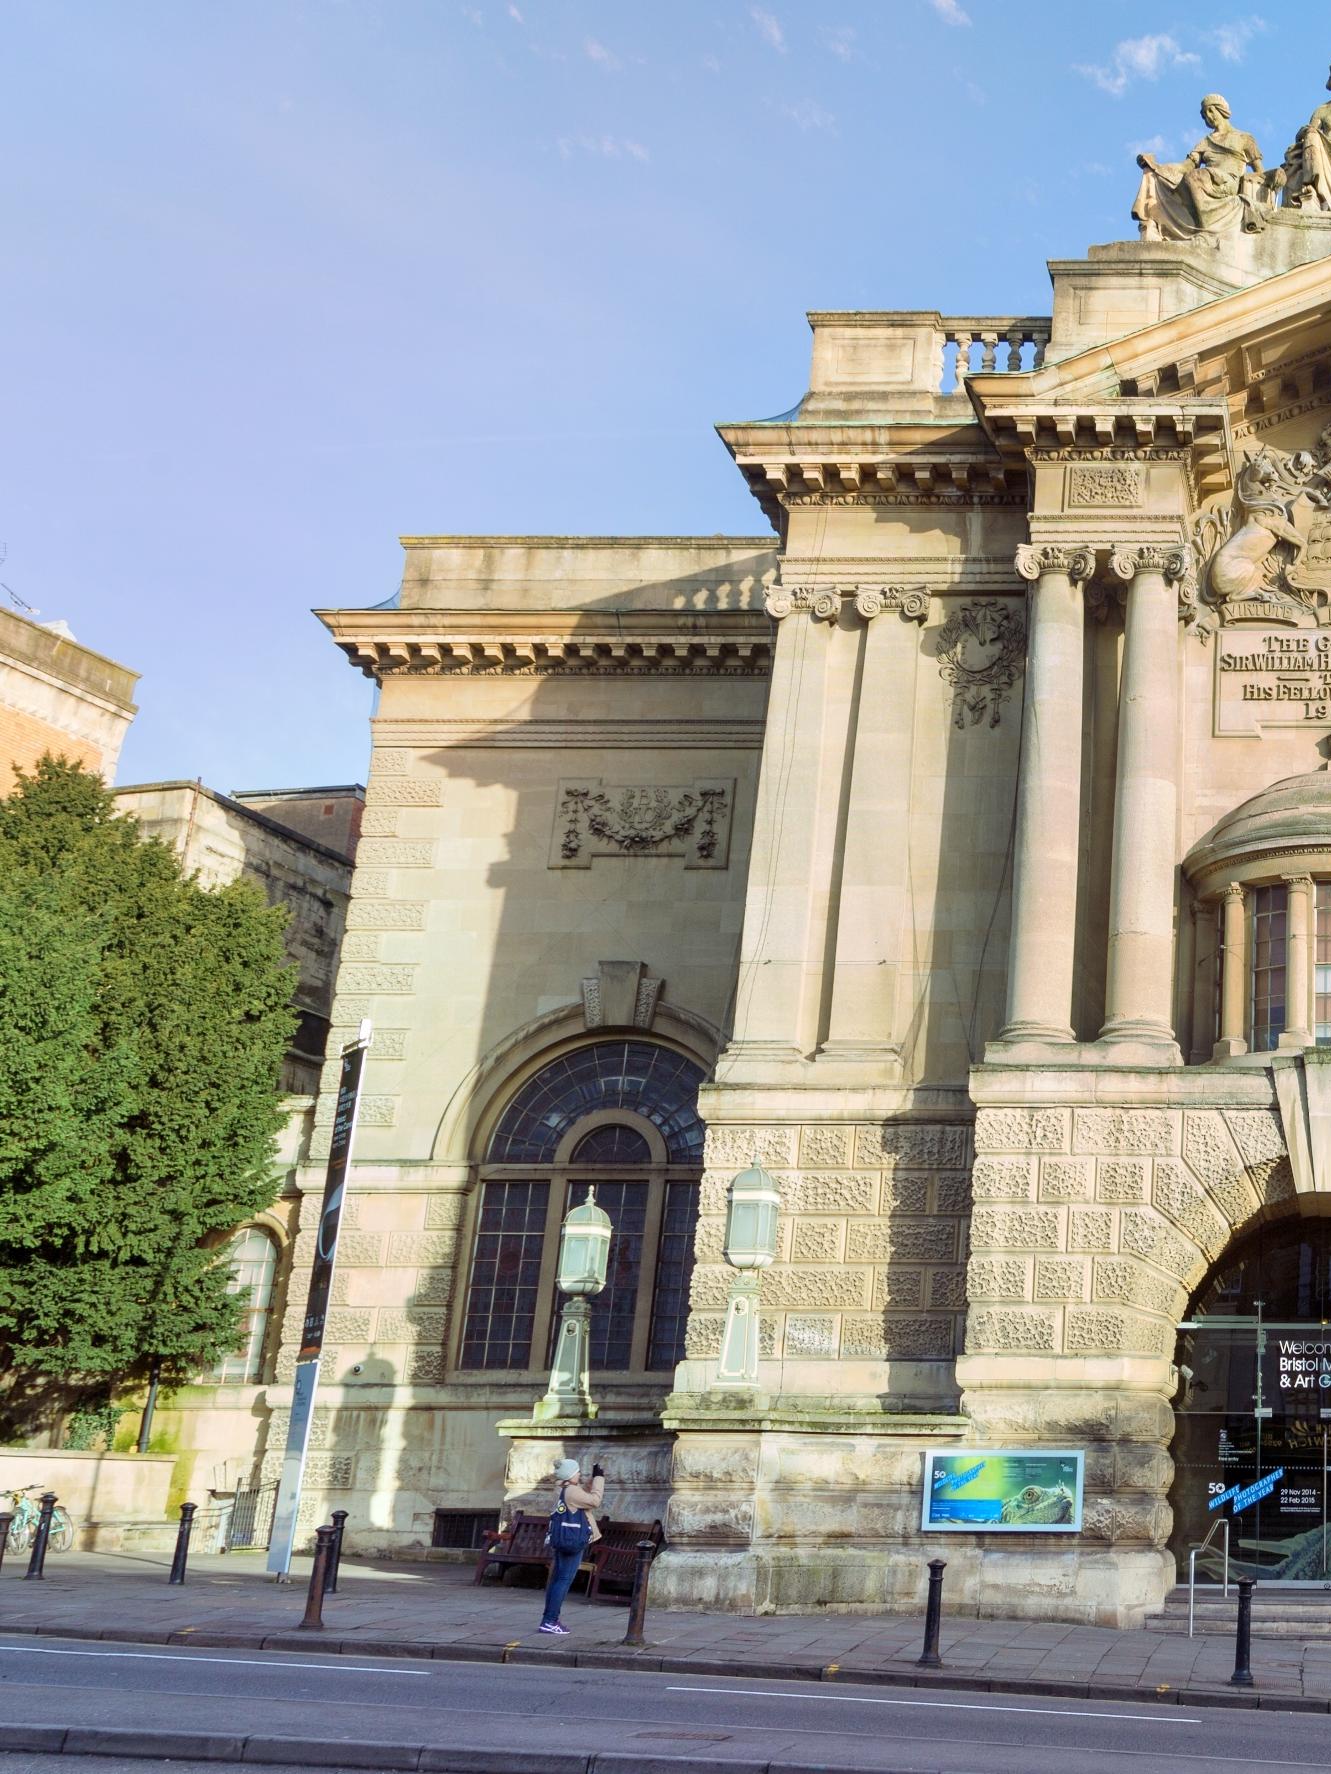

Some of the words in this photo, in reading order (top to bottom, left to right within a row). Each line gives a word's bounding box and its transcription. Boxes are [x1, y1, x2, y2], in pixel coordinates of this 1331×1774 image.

[1224, 602, 1293, 619] VIRTUTE
[1262, 636, 1309, 652] THE
[1220, 653, 1250, 672] SIR
[1250, 653, 1314, 672] WILLIAM
[1242, 684, 1274, 700] HIS
[1280, 1357, 1318, 1371] Bristol
[1280, 1374, 1291, 1388] &
[1294, 1374, 1315, 1388] Art
[934, 1470, 946, 1478] 50
[1208, 1482, 1226, 1494] 50
[1233, 1469, 1284, 1503] PHOTOGRAPHER
[1258, 1485, 1274, 1498] YEAR
[1280, 1488, 1288, 1496] 29
[1288, 1488, 1301, 1496] Nov
[1301, 1488, 1316, 1496] 2014
[1208, 1484, 1240, 1509] WILDLIFE
[1280, 1496, 1288, 1504] 22
[1288, 1496, 1300, 1504] Feb
[1301, 1496, 1316, 1504] 2015
